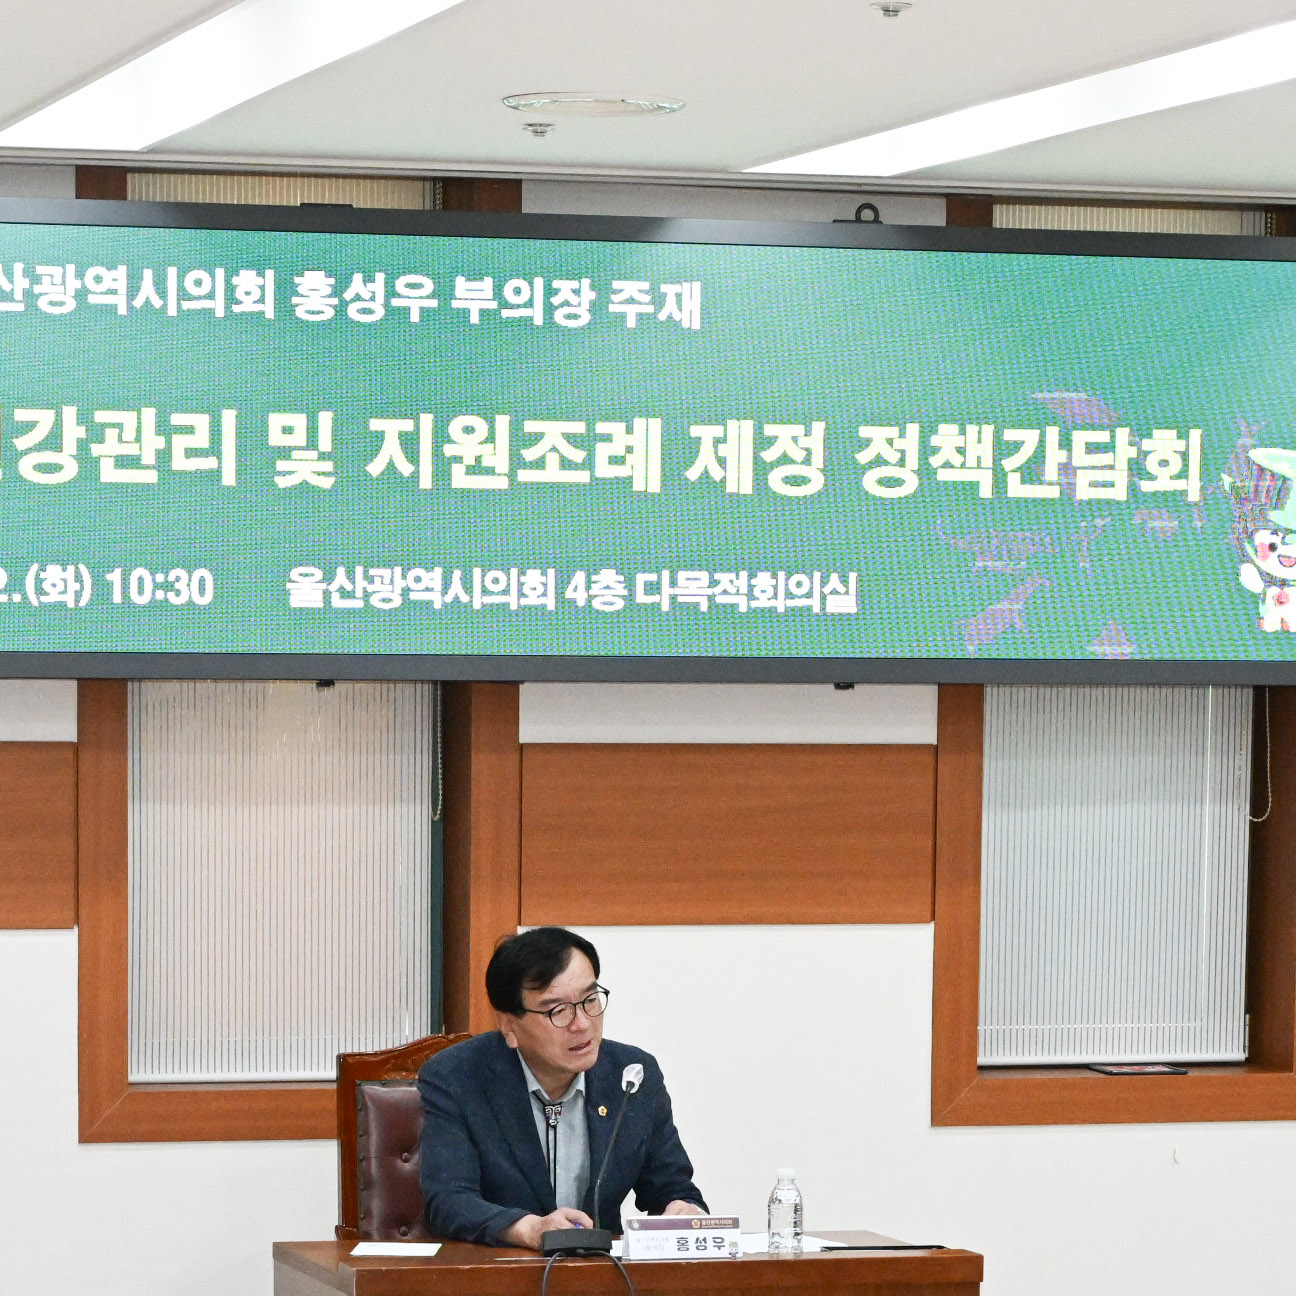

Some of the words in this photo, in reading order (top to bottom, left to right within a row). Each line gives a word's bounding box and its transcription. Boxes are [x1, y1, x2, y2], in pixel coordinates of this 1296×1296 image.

[290, 270, 439, 324] 홍성우
[450, 276, 597, 328] 부의장
[607, 280, 703, 331] 주재
[267, 410, 337, 490] 및
[364, 412, 663, 493] 지원조례
[684, 418, 827, 497] 제정
[853, 421, 1203, 503] 정책간담회
[104, 566, 215, 607] 10:30
[284, 564, 557, 612] 울산광역시의회
[564, 567, 629, 613] 4층
[634, 568, 859, 615] 다목적회의실
[675, 1236, 726, 1252] 홍성우
